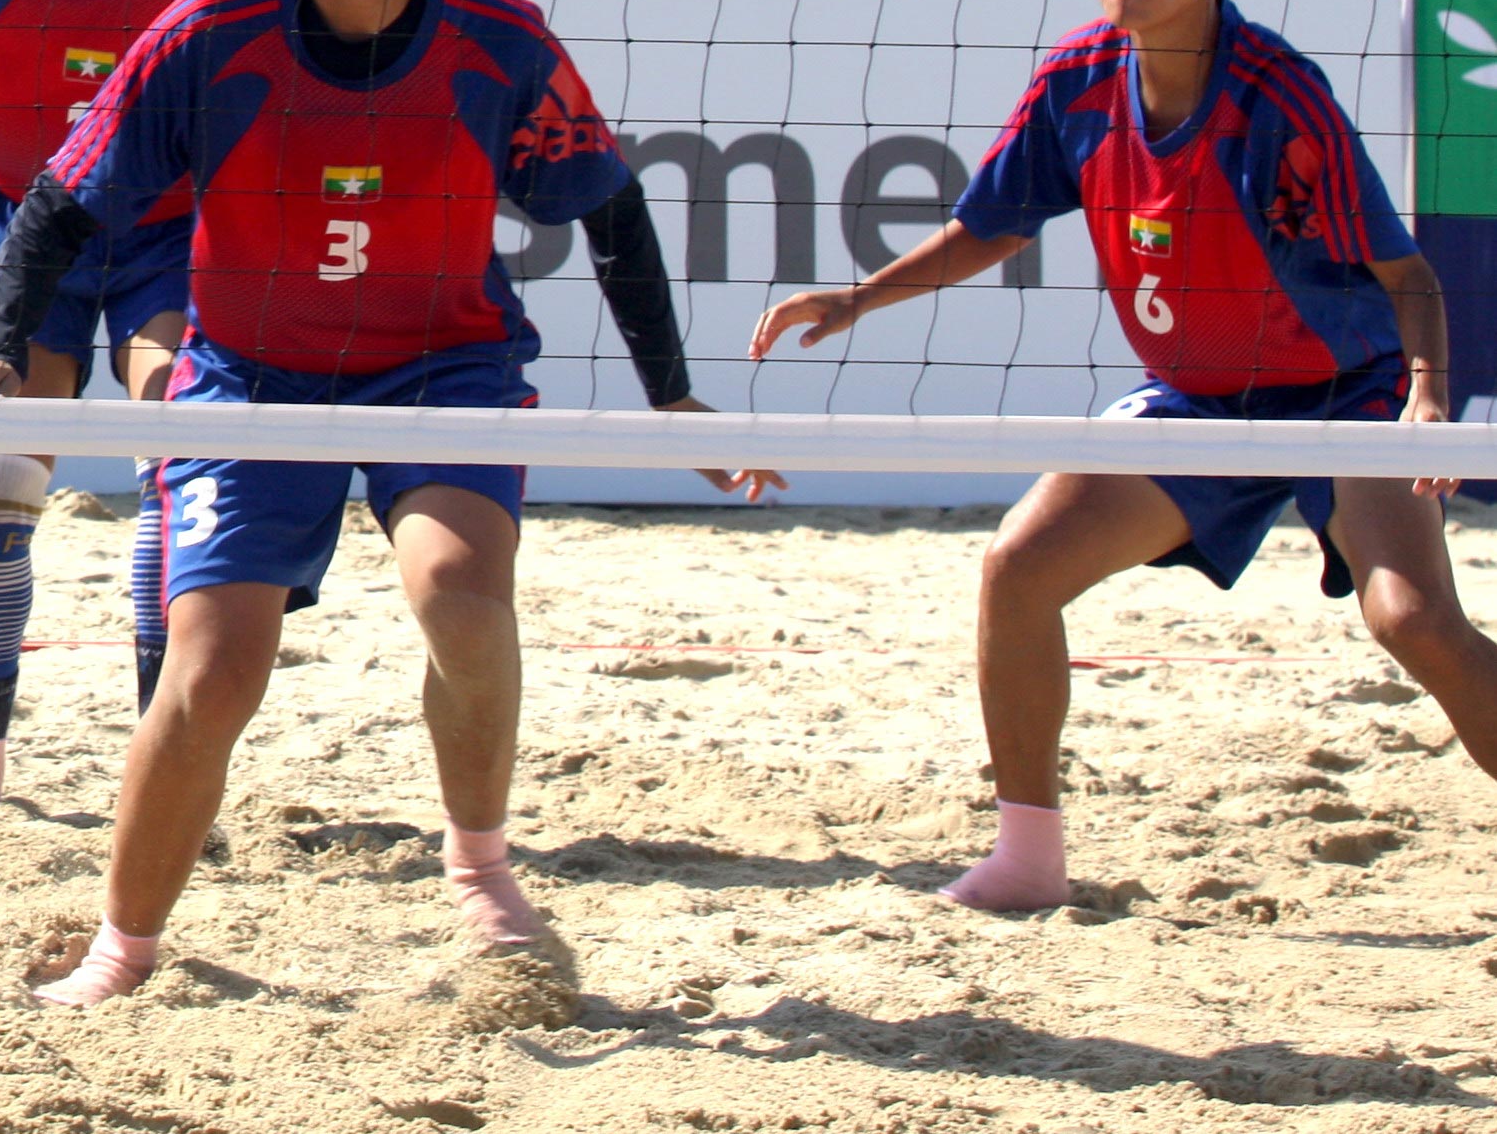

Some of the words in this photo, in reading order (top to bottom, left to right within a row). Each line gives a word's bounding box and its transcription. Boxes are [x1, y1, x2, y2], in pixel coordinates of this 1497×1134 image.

[318, 219, 371, 282] 3
[1134, 275, 1175, 335] 6
[175, 476, 219, 548] 3
